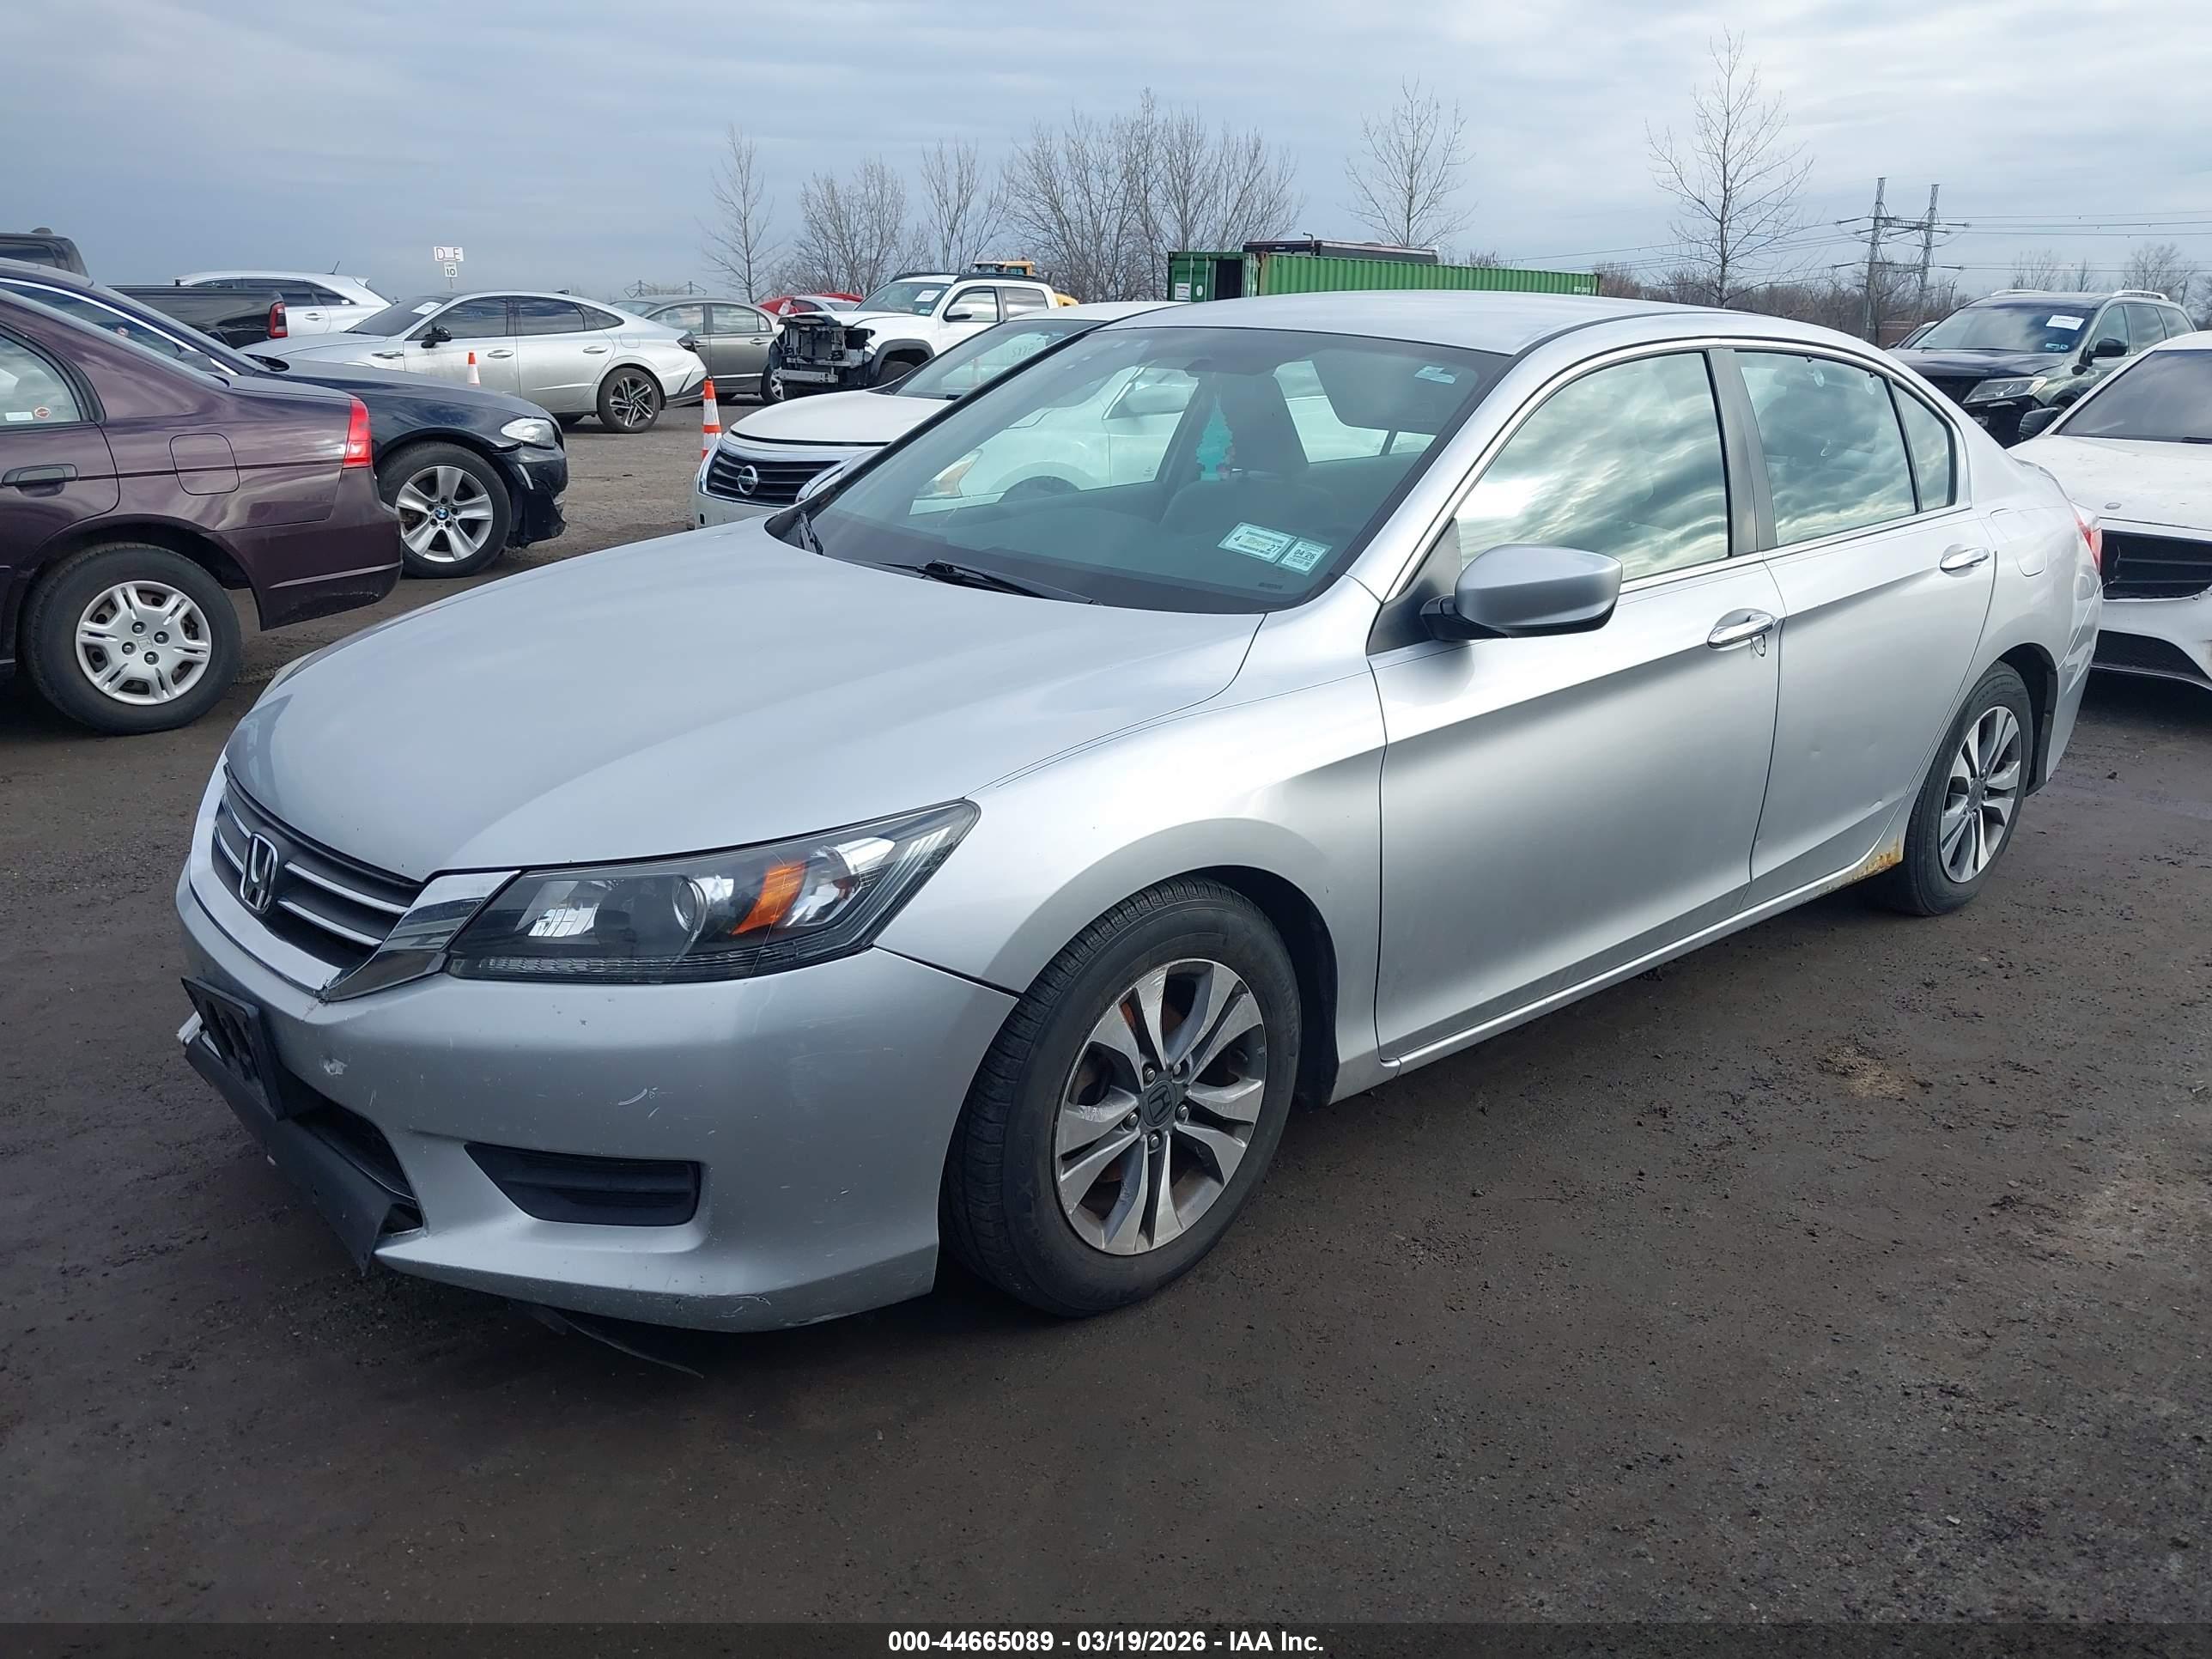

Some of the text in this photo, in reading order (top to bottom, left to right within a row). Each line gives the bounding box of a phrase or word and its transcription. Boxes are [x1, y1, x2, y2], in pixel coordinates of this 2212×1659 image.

[446, 268, 456, 276] 10
[1266, 544, 1282, 553] 27
[1305, 551, 1316, 560] 26
